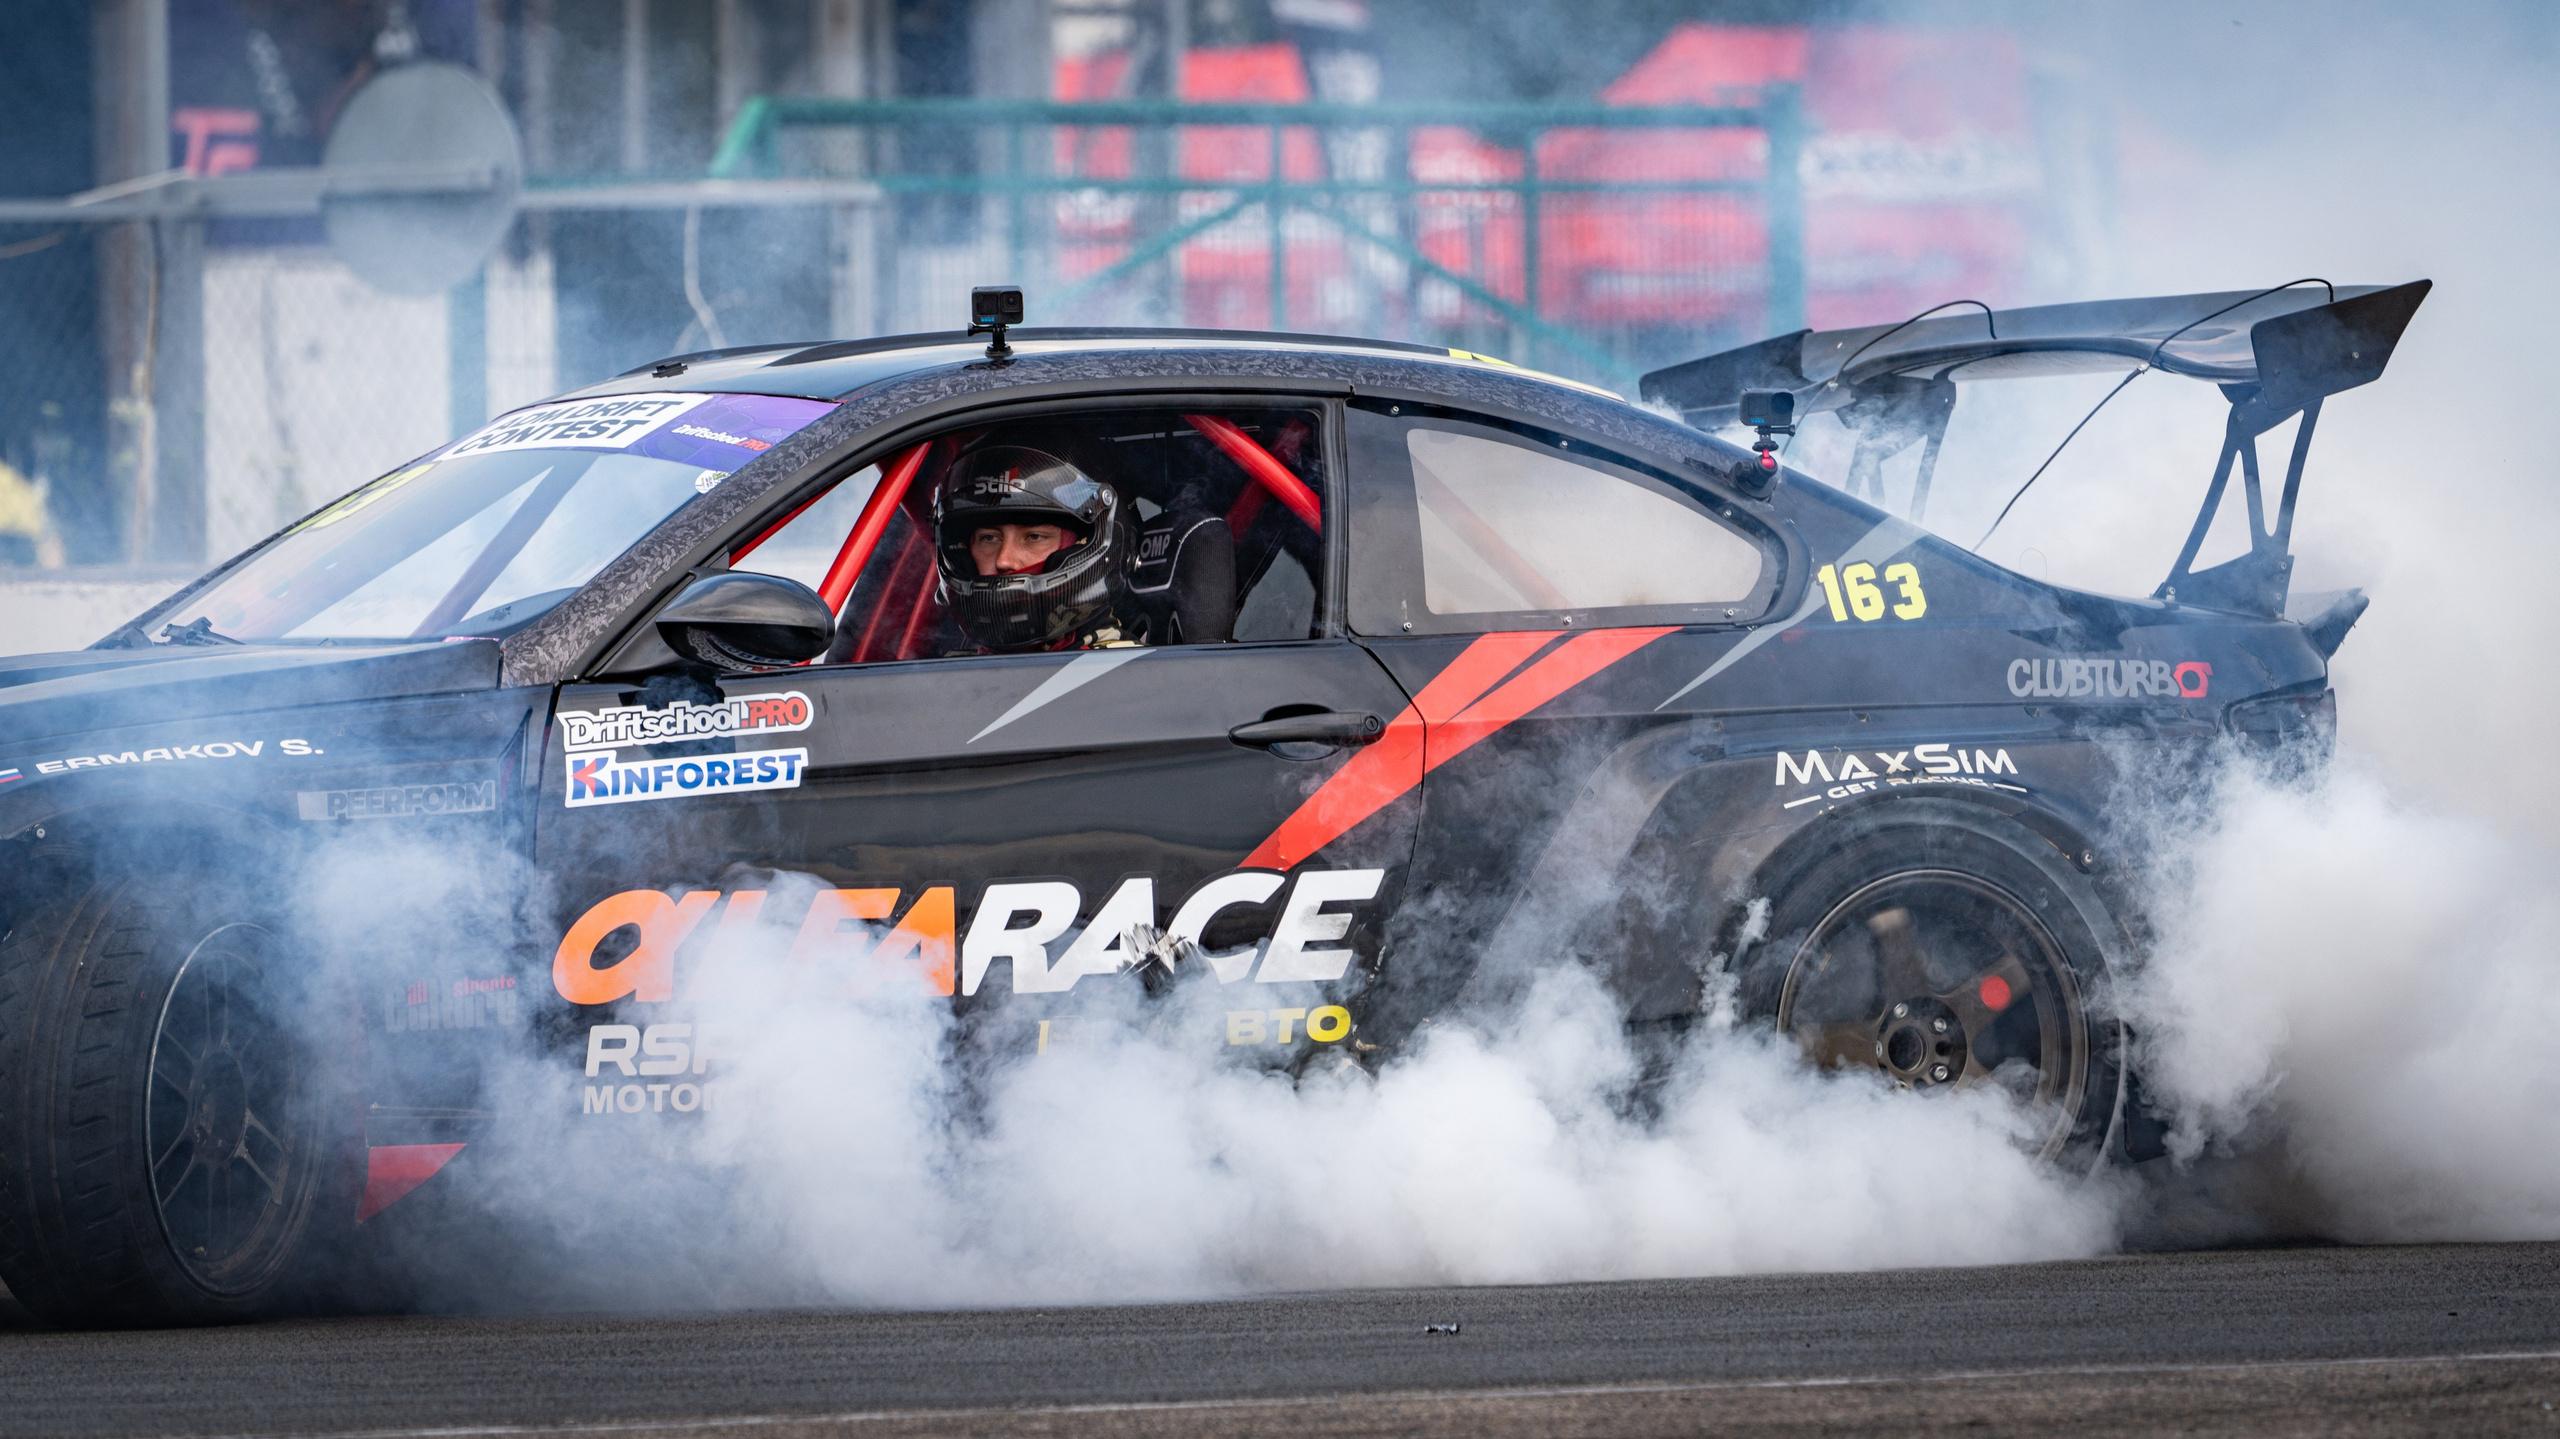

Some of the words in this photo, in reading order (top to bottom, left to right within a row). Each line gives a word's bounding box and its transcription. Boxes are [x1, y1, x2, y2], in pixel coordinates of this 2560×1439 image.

[567, 401, 683, 420] DRIFT
[452, 418, 650, 456] CONTEST
[1140, 534, 1171, 559] OMP
[1817, 562, 1928, 622] 163
[35, 741, 264, 775] ERMAKOV
[279, 739, 325, 756] S.
[571, 754, 802, 800] KINFOREST
[1827, 780, 1878, 799] GET
[327, 781, 493, 818] PEERFORM
